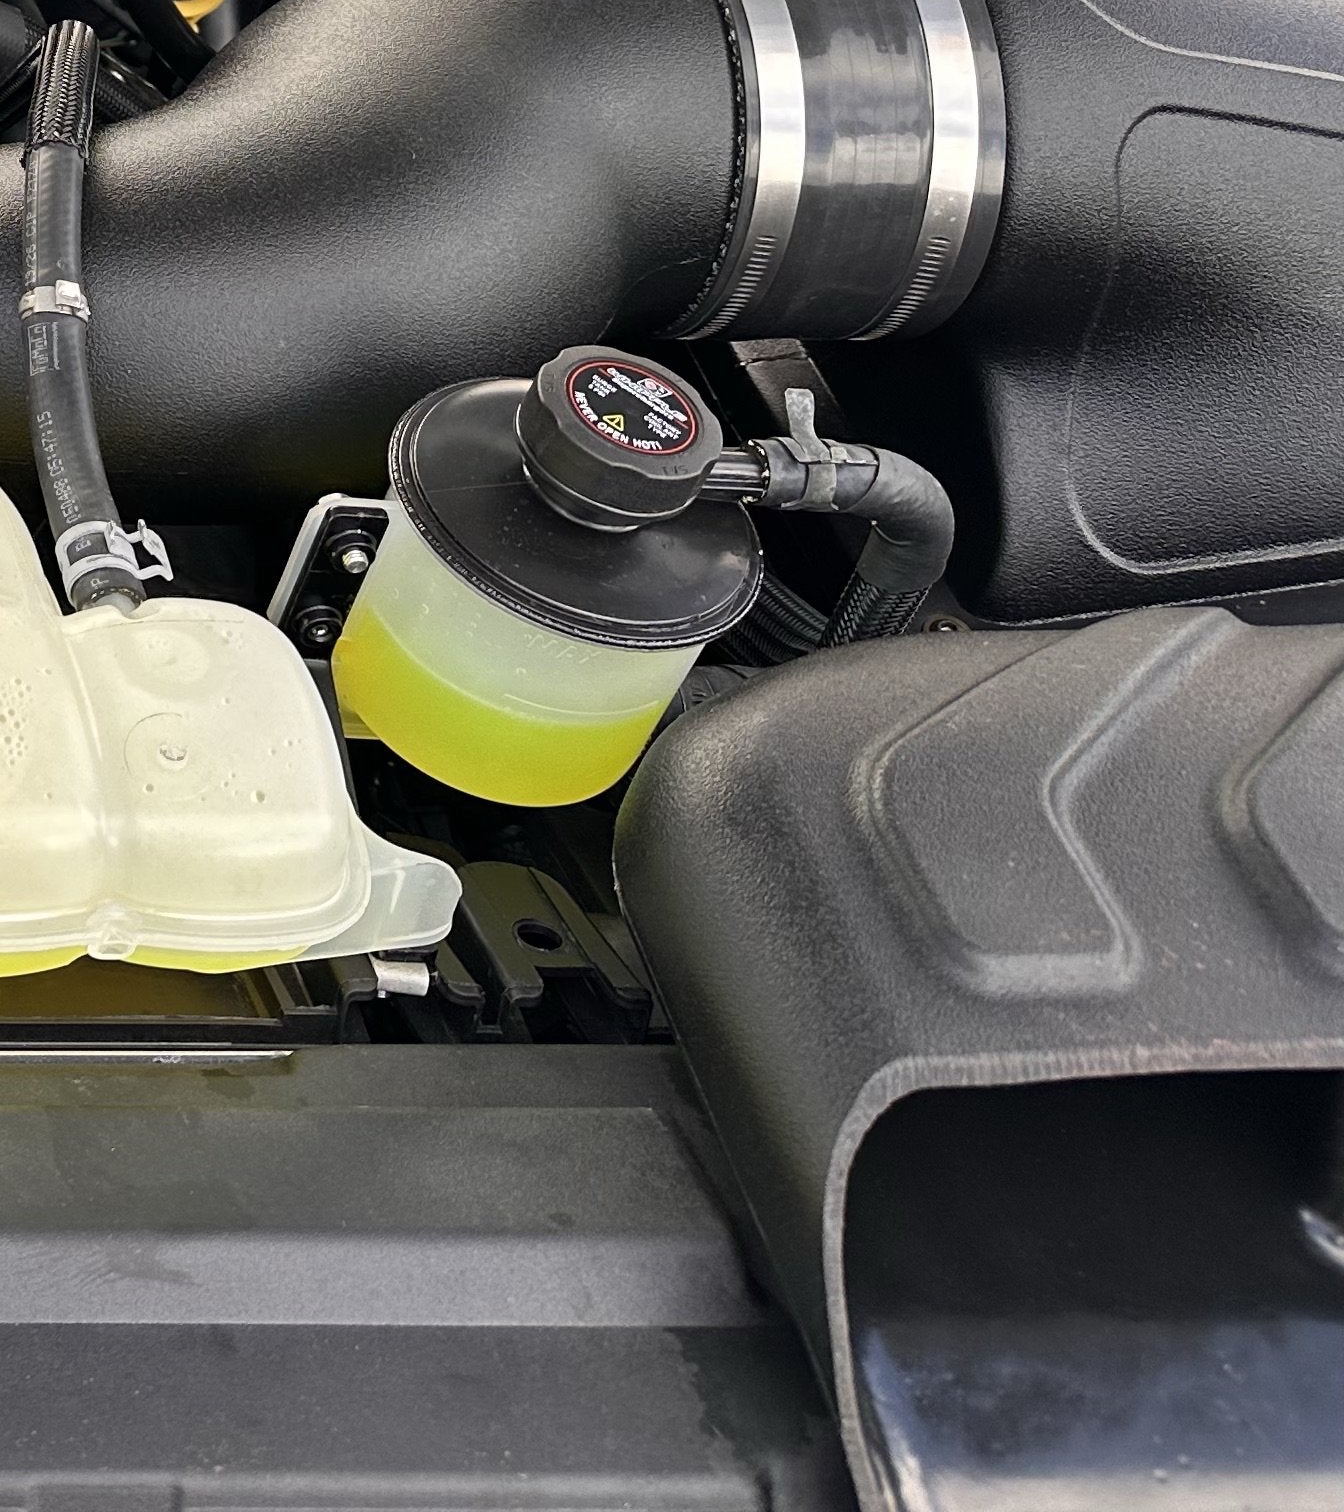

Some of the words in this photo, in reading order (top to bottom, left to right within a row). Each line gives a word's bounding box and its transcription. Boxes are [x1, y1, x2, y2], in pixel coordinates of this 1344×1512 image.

[36, 410, 64, 478] 05:47:15
[574, 390, 599, 422] NEVER
[597, 421, 629, 444] OPEN
[632, 438, 662, 450] HOT!
